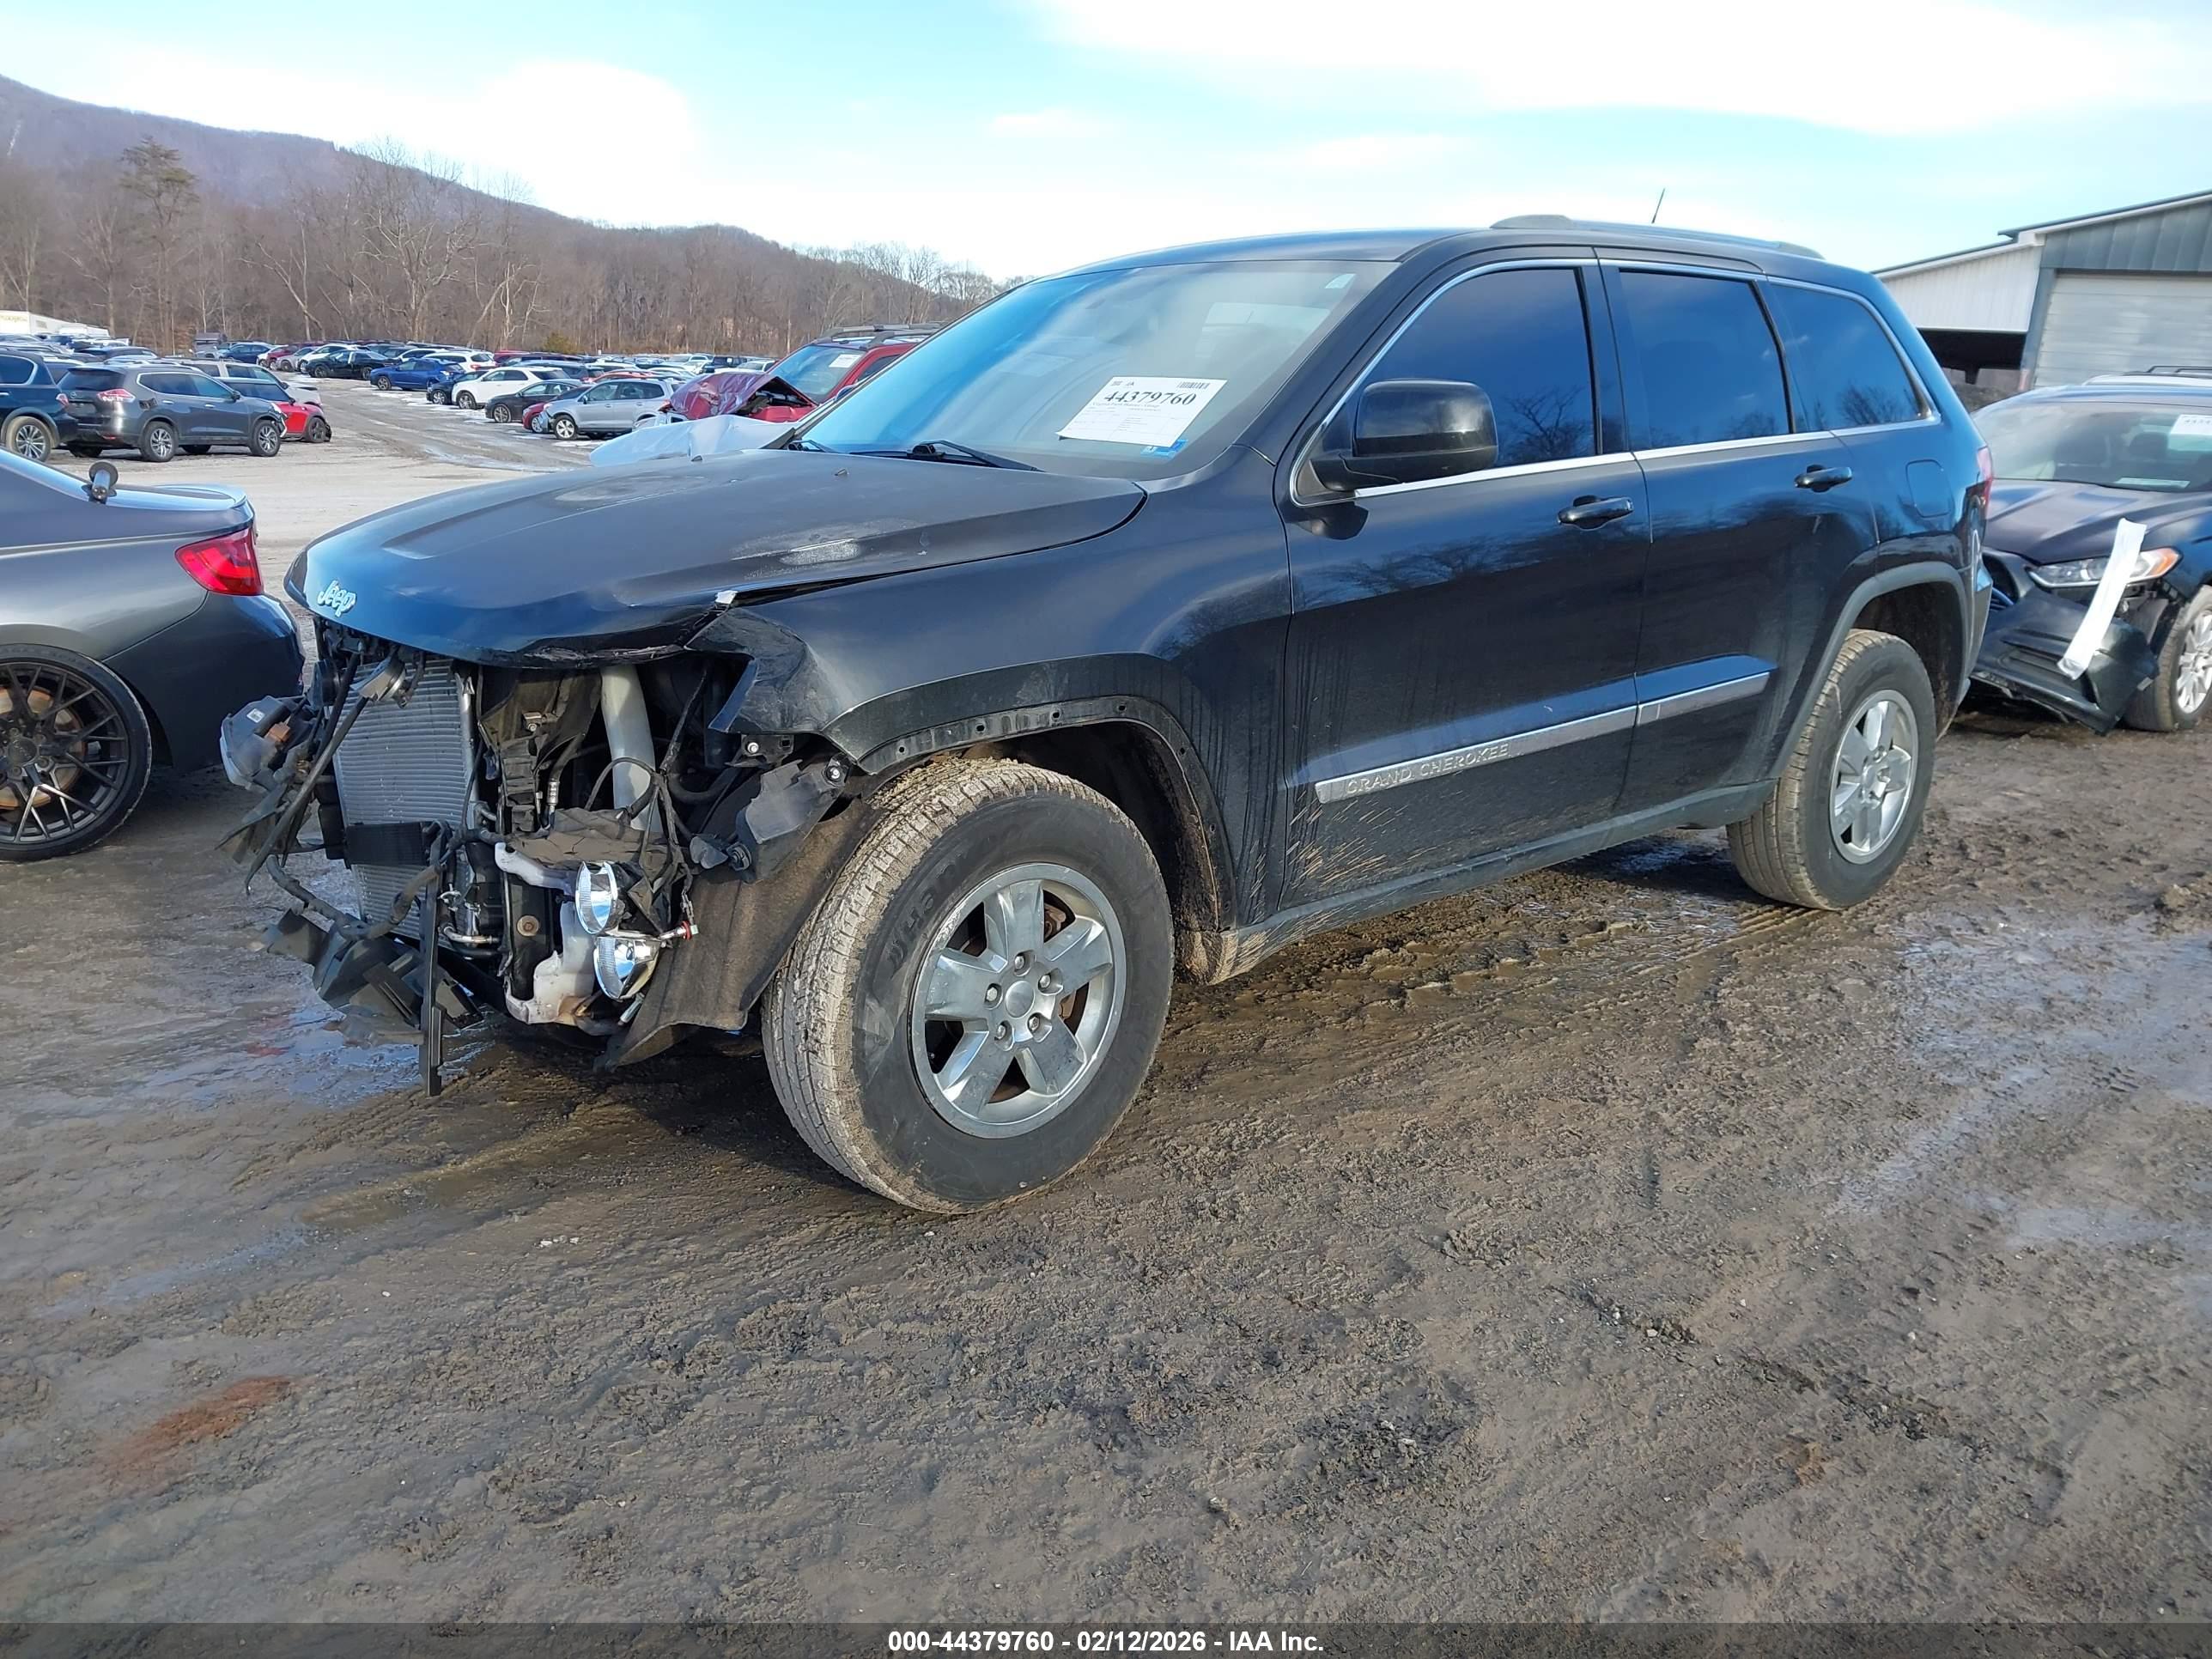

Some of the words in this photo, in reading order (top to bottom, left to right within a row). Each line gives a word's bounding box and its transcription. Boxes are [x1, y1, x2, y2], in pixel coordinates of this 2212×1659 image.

[1104, 390, 1197, 406] 44379760
[318, 580, 356, 617] Jeep
[1346, 767, 1413, 794] GRAND
[1420, 743, 1510, 777] CHEROKEE
